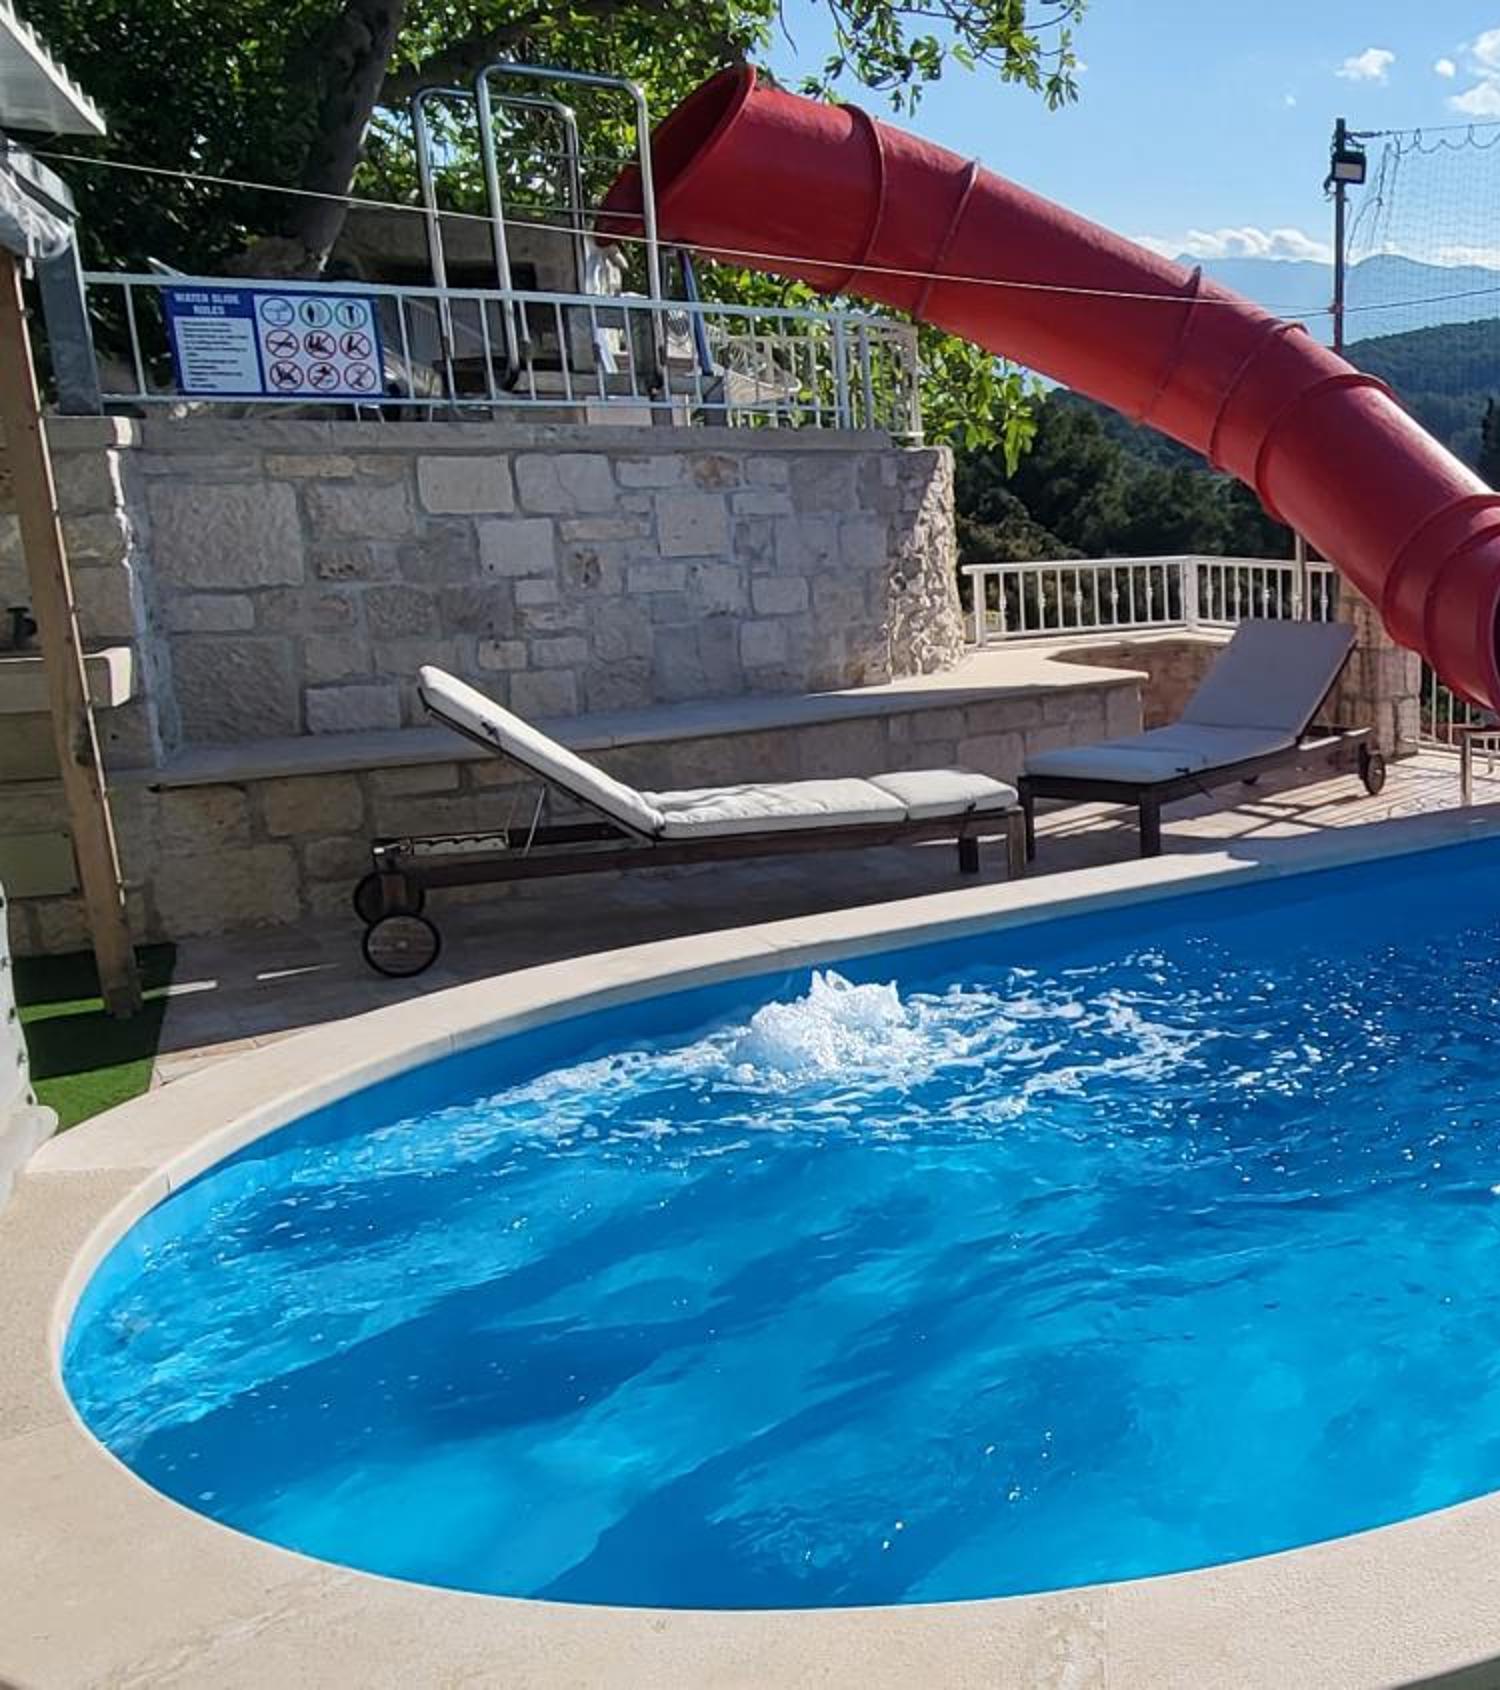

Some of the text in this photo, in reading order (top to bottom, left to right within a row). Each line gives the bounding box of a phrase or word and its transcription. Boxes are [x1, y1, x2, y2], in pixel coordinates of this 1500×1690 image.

[173, 293, 240, 304] WATER SLIDE
[193, 305, 225, 315] RULES
